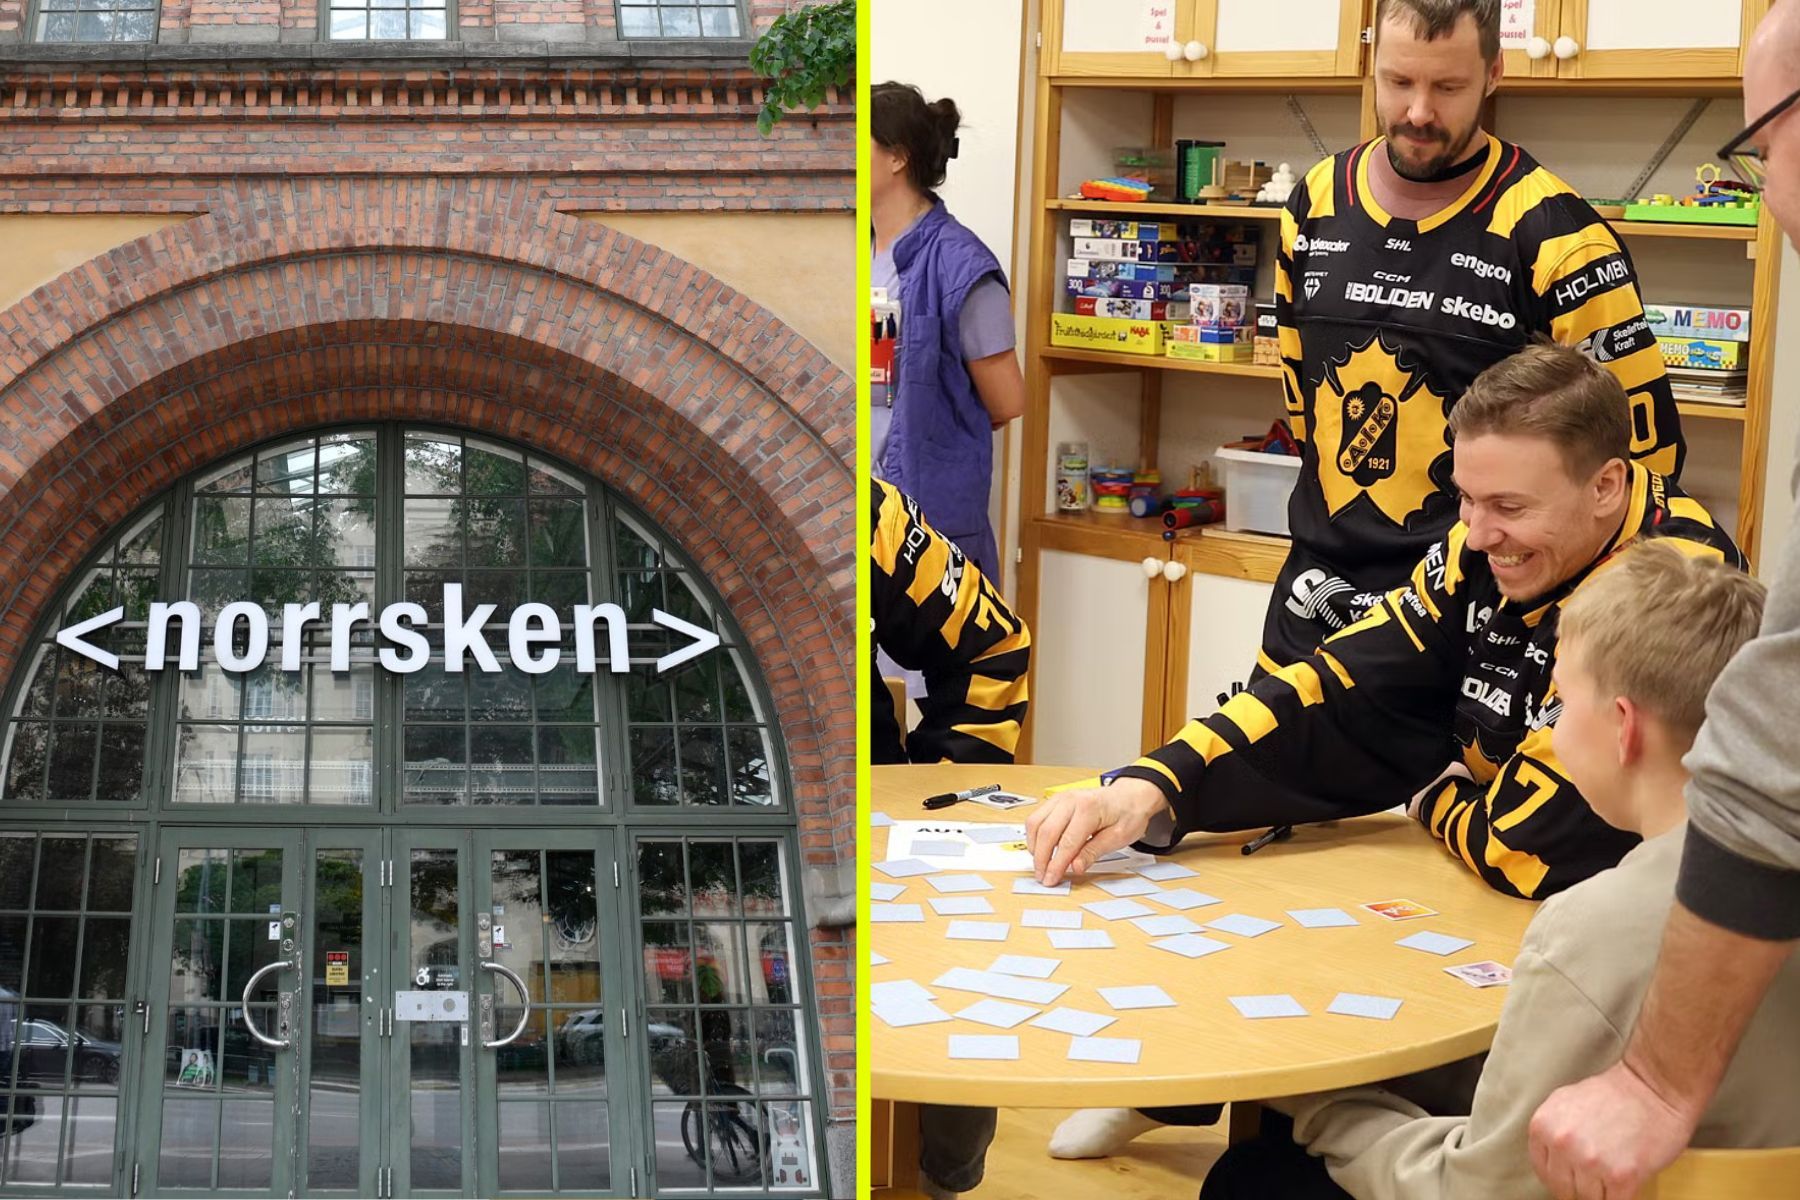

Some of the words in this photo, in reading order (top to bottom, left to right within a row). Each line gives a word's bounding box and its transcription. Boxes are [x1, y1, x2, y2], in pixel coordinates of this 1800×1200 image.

[1384, 238, 1412, 251] SHL
[1373, 270, 1411, 283] CCM
[1555, 259, 1629, 306] HOLMEN
[1440, 296, 1516, 329] skebo
[1674, 309, 1742, 330] MEMO
[1614, 337, 1636, 353] Kraft
[1660, 342, 1690, 355] MEMO
[1368, 457, 1390, 470] 1921
[1487, 631, 1521, 646] SHL
[1480, 662, 1519, 679] CCM
